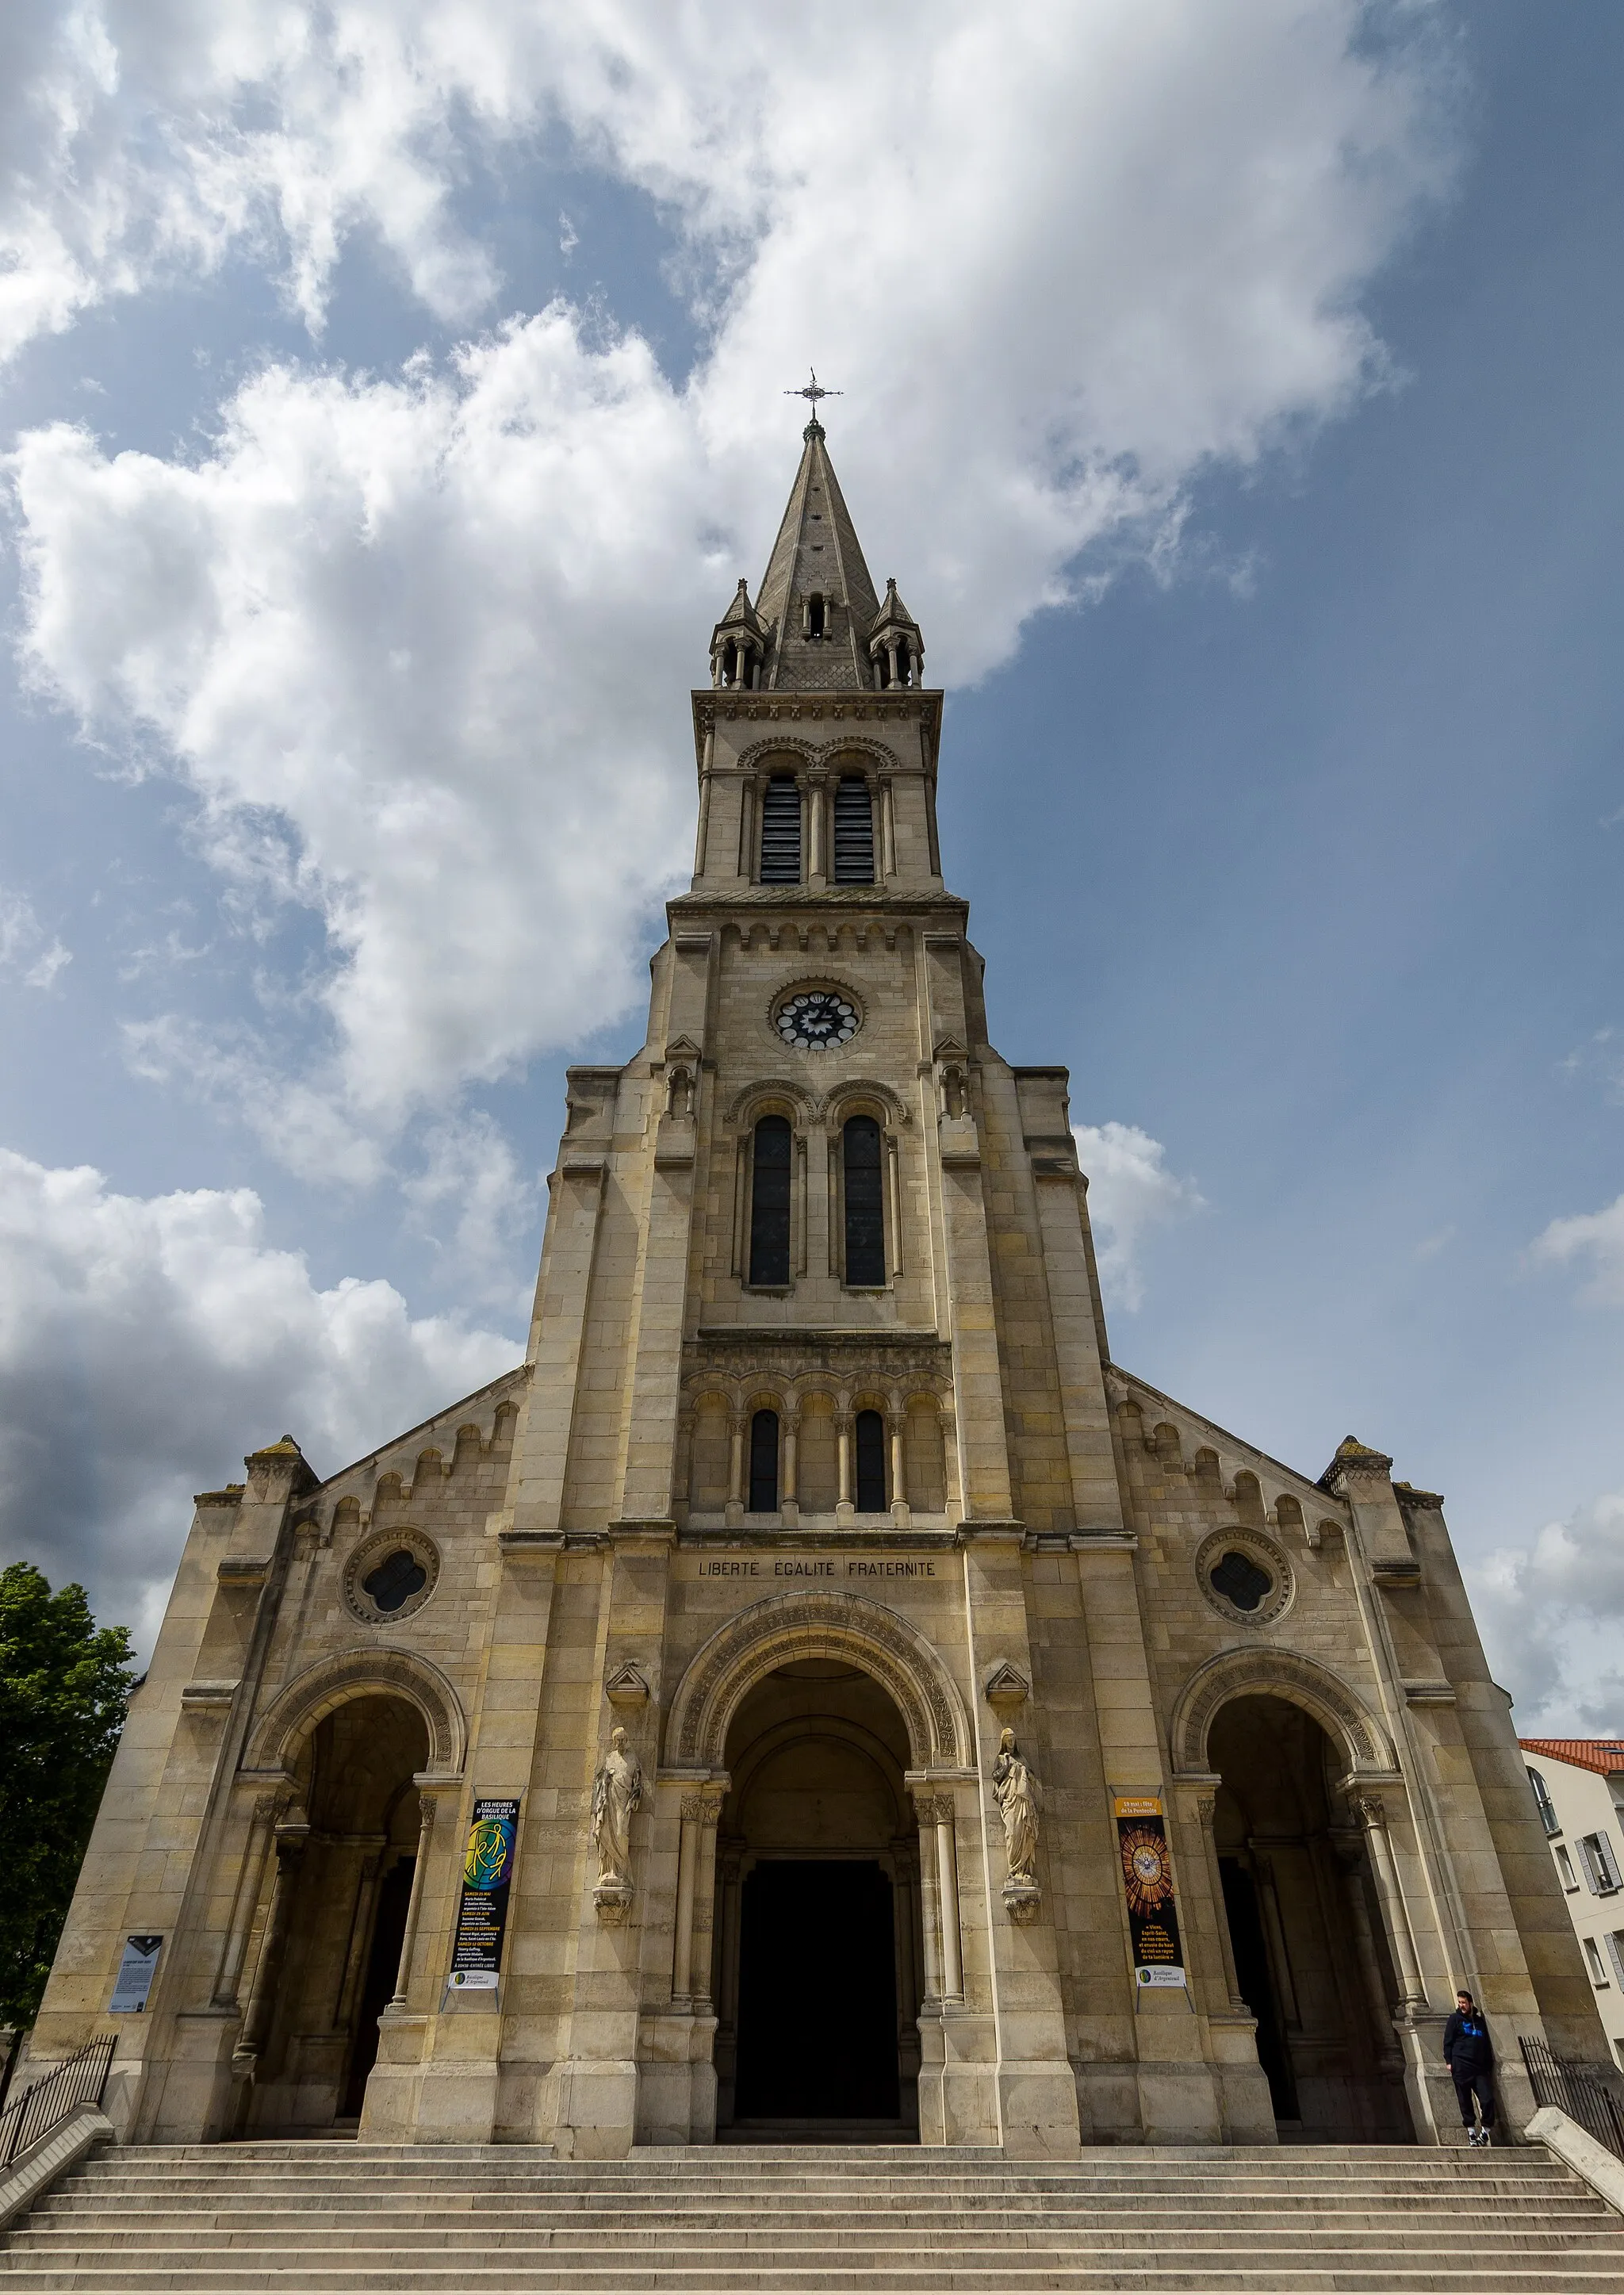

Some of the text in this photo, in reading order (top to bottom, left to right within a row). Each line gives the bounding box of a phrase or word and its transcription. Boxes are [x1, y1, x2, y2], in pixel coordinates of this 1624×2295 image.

[699, 1559, 935, 1575] LIBERTÉ ÉGALITÉ FRATERNITÉ
